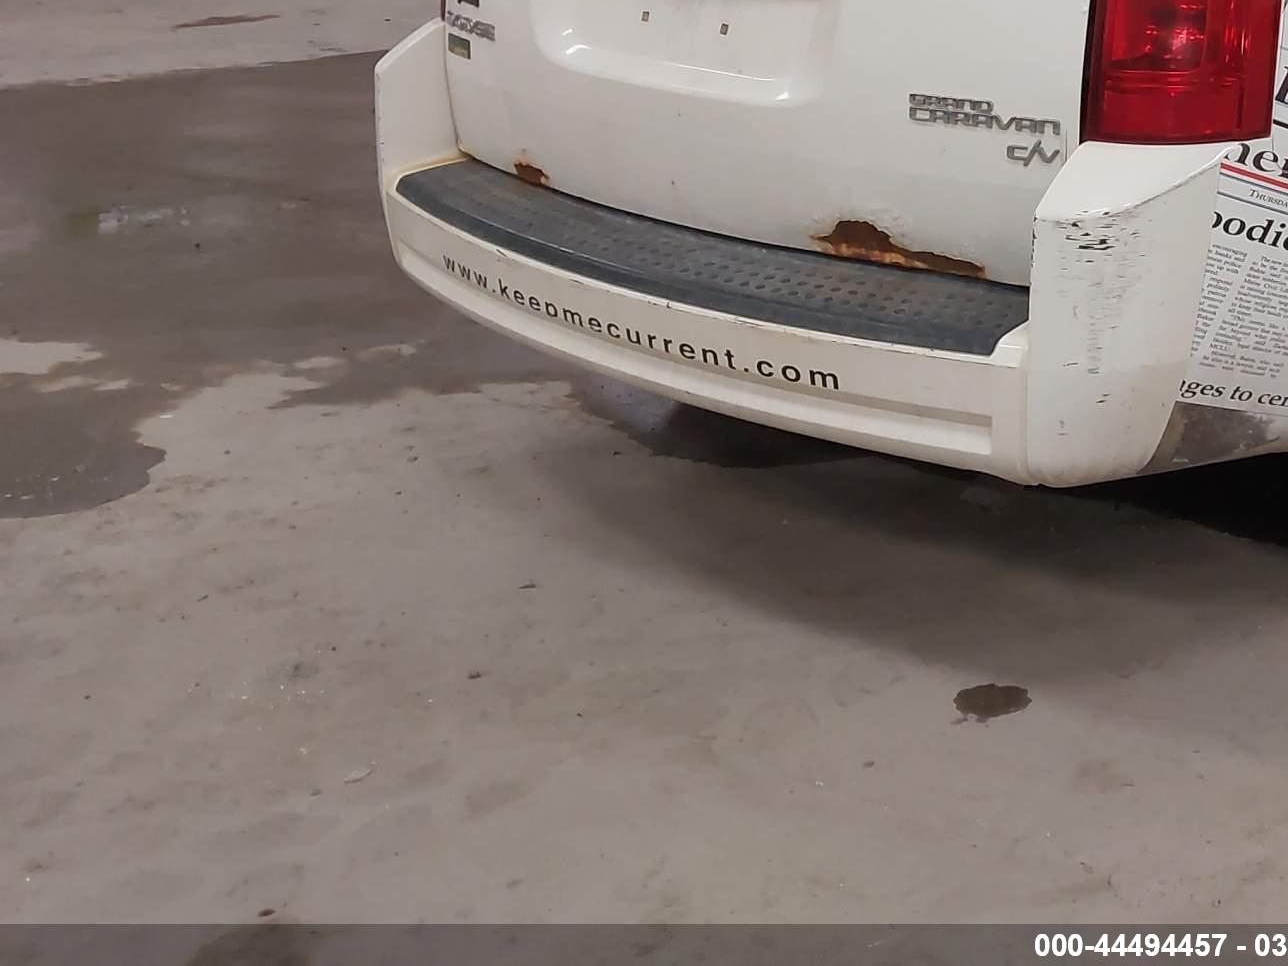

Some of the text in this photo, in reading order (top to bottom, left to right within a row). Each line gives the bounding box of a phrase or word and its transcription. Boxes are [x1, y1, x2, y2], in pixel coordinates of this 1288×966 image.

[909, 93, 994, 114] GRAND
[909, 106, 1061, 135] CARAVAN
[442, 253, 840, 390] www.keepmecurrent.com
[1230, 385, 1253, 401] to
